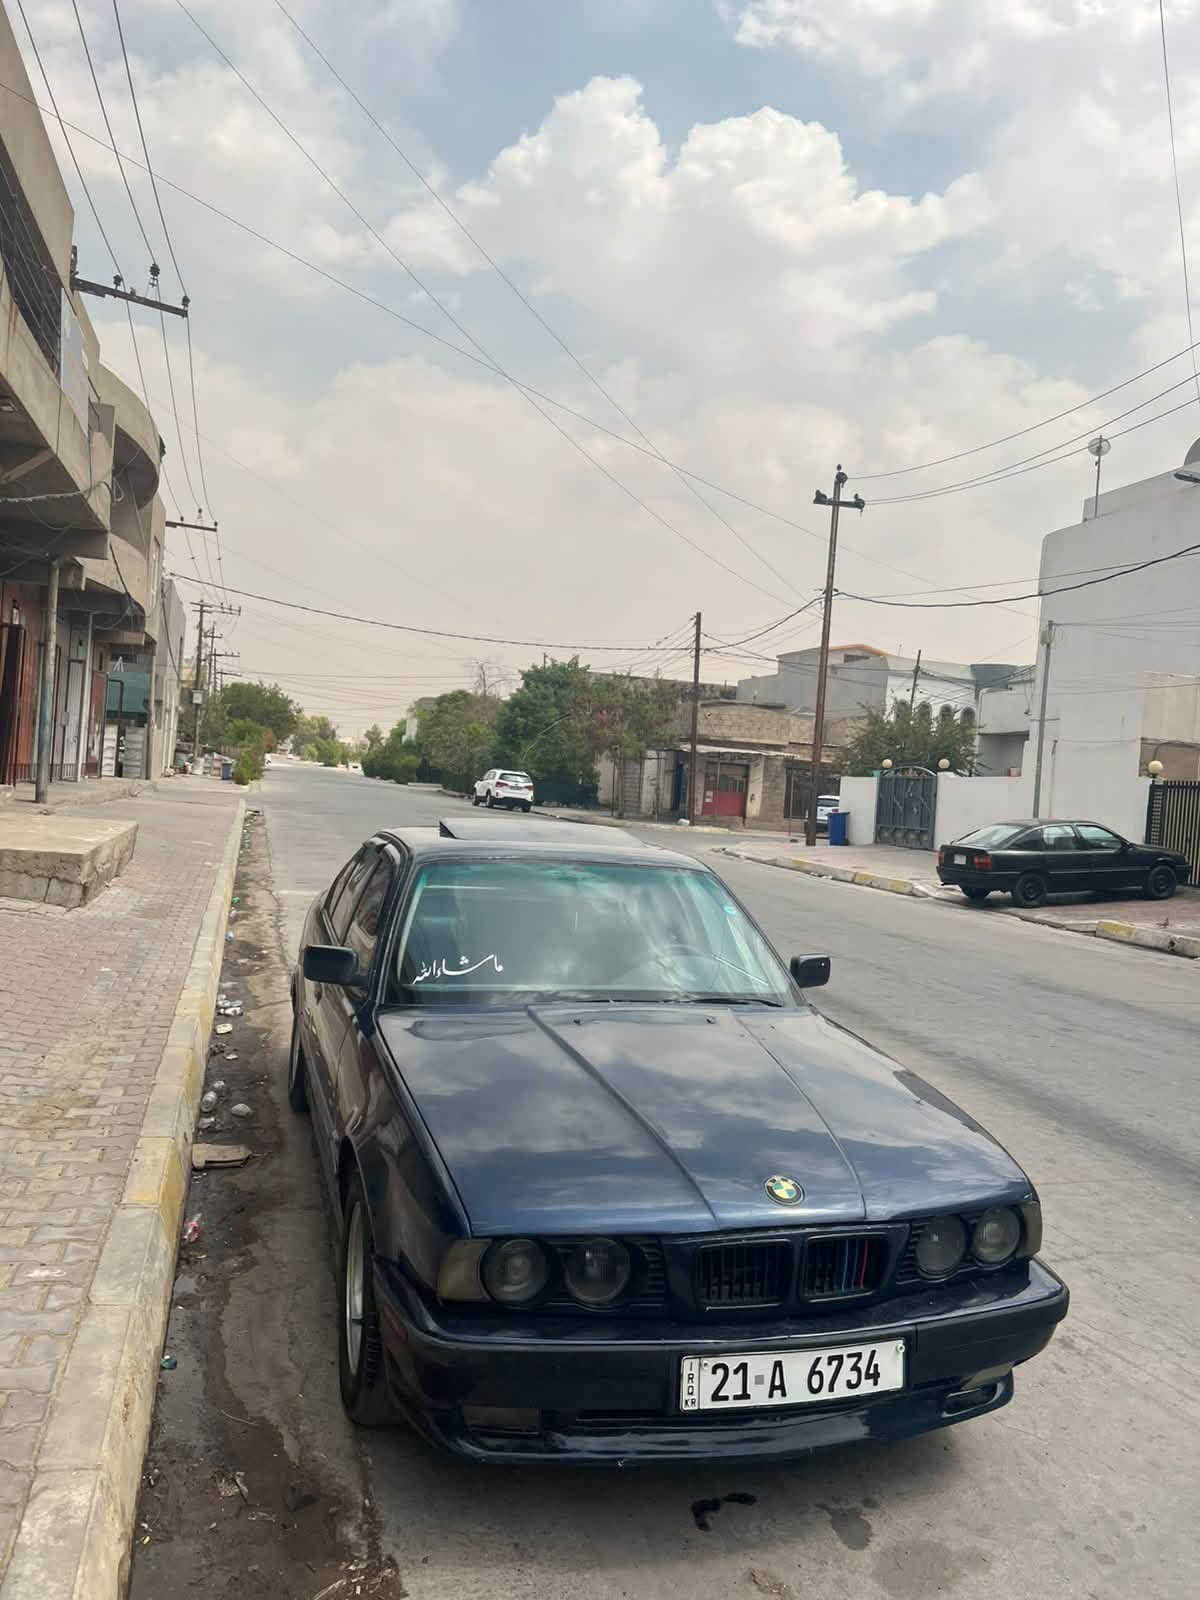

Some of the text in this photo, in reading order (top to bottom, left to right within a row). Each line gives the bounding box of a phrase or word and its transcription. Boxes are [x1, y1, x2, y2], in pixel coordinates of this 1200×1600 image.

[711, 1350, 881, 1402] 21 A 6734
